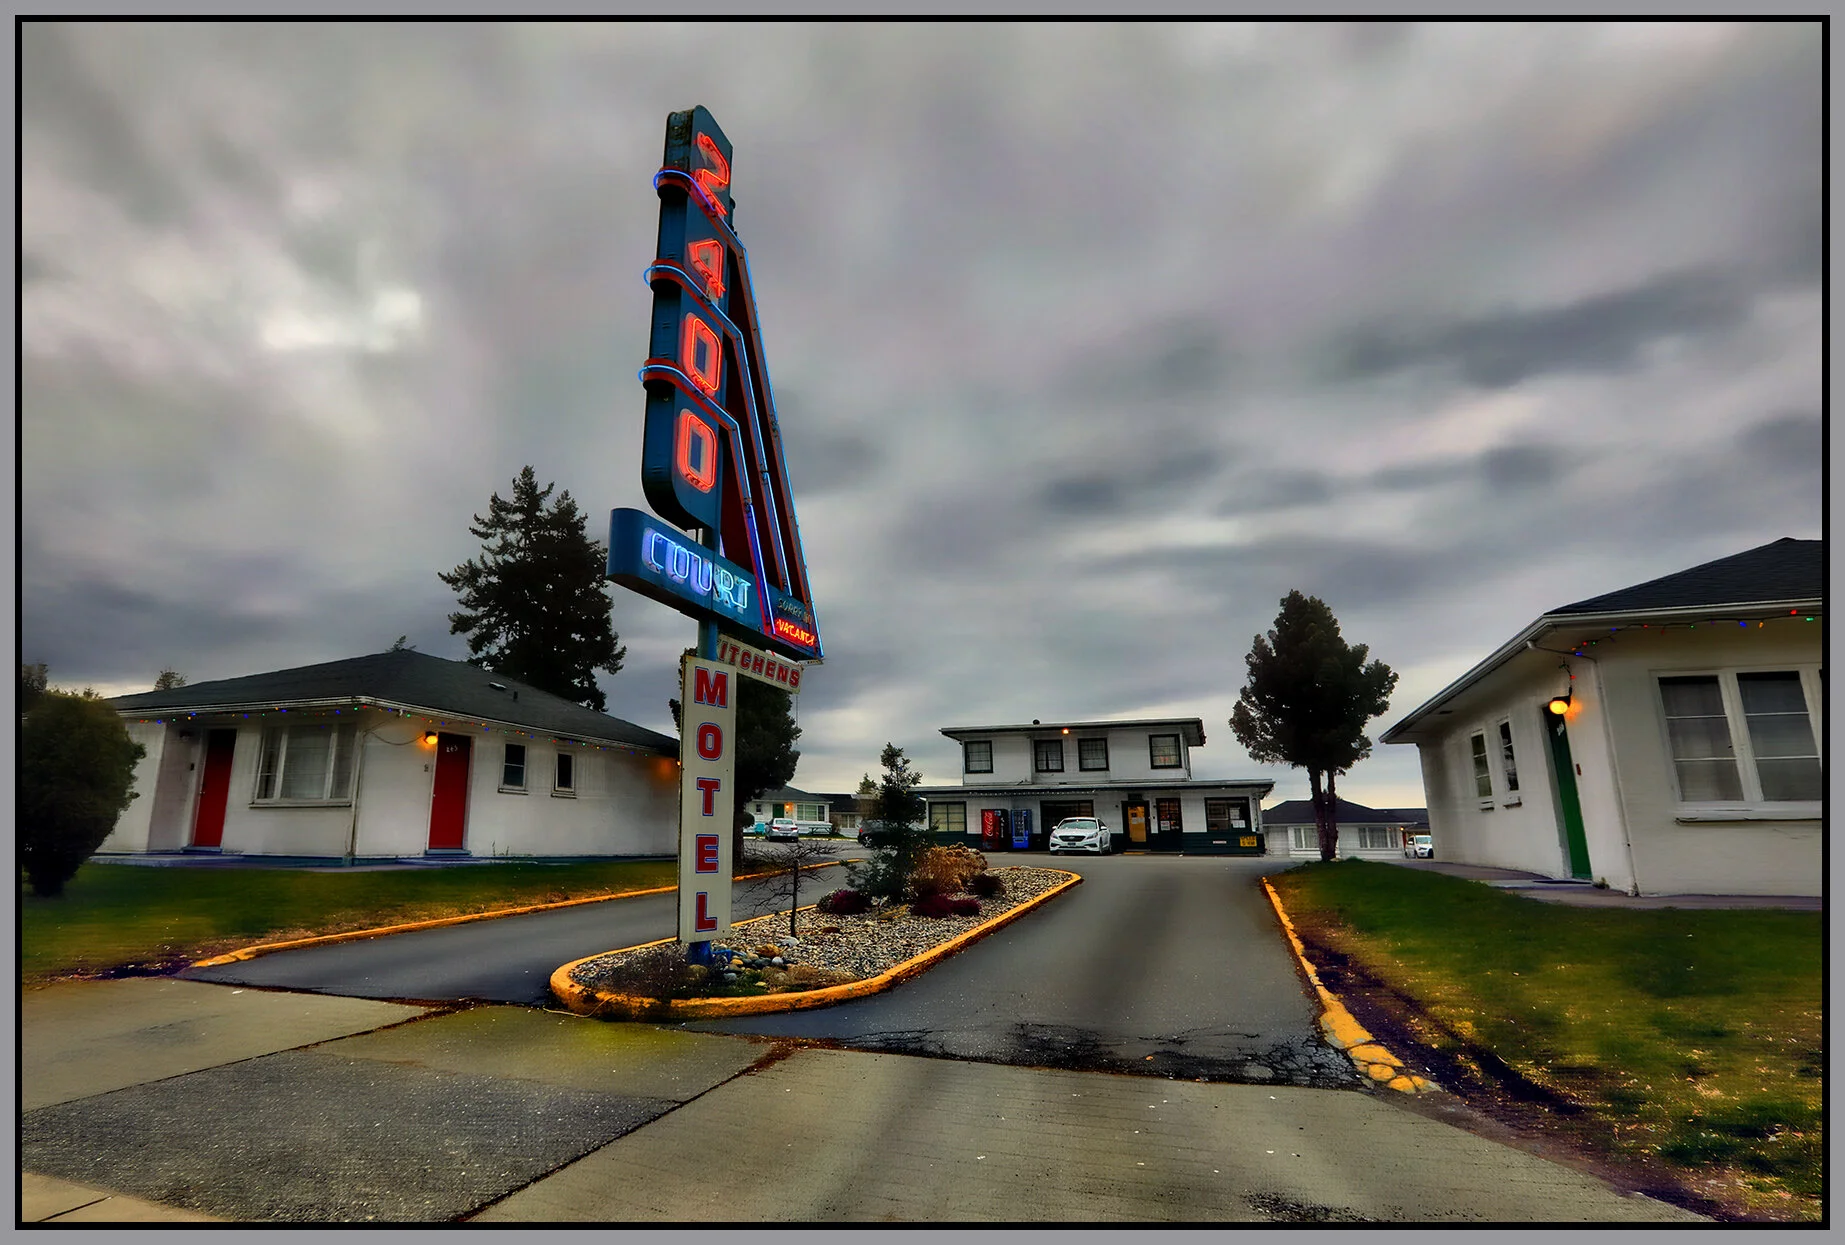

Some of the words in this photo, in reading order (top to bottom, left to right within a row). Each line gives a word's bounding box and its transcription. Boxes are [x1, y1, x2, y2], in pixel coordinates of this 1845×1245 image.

[676, 131, 731, 494] 2400
[641, 526, 752, 615] COURT
[777, 598, 803, 618] SORRY
[717, 639, 801, 689] ITCHENS
[694, 666, 728, 932] MOTEL
